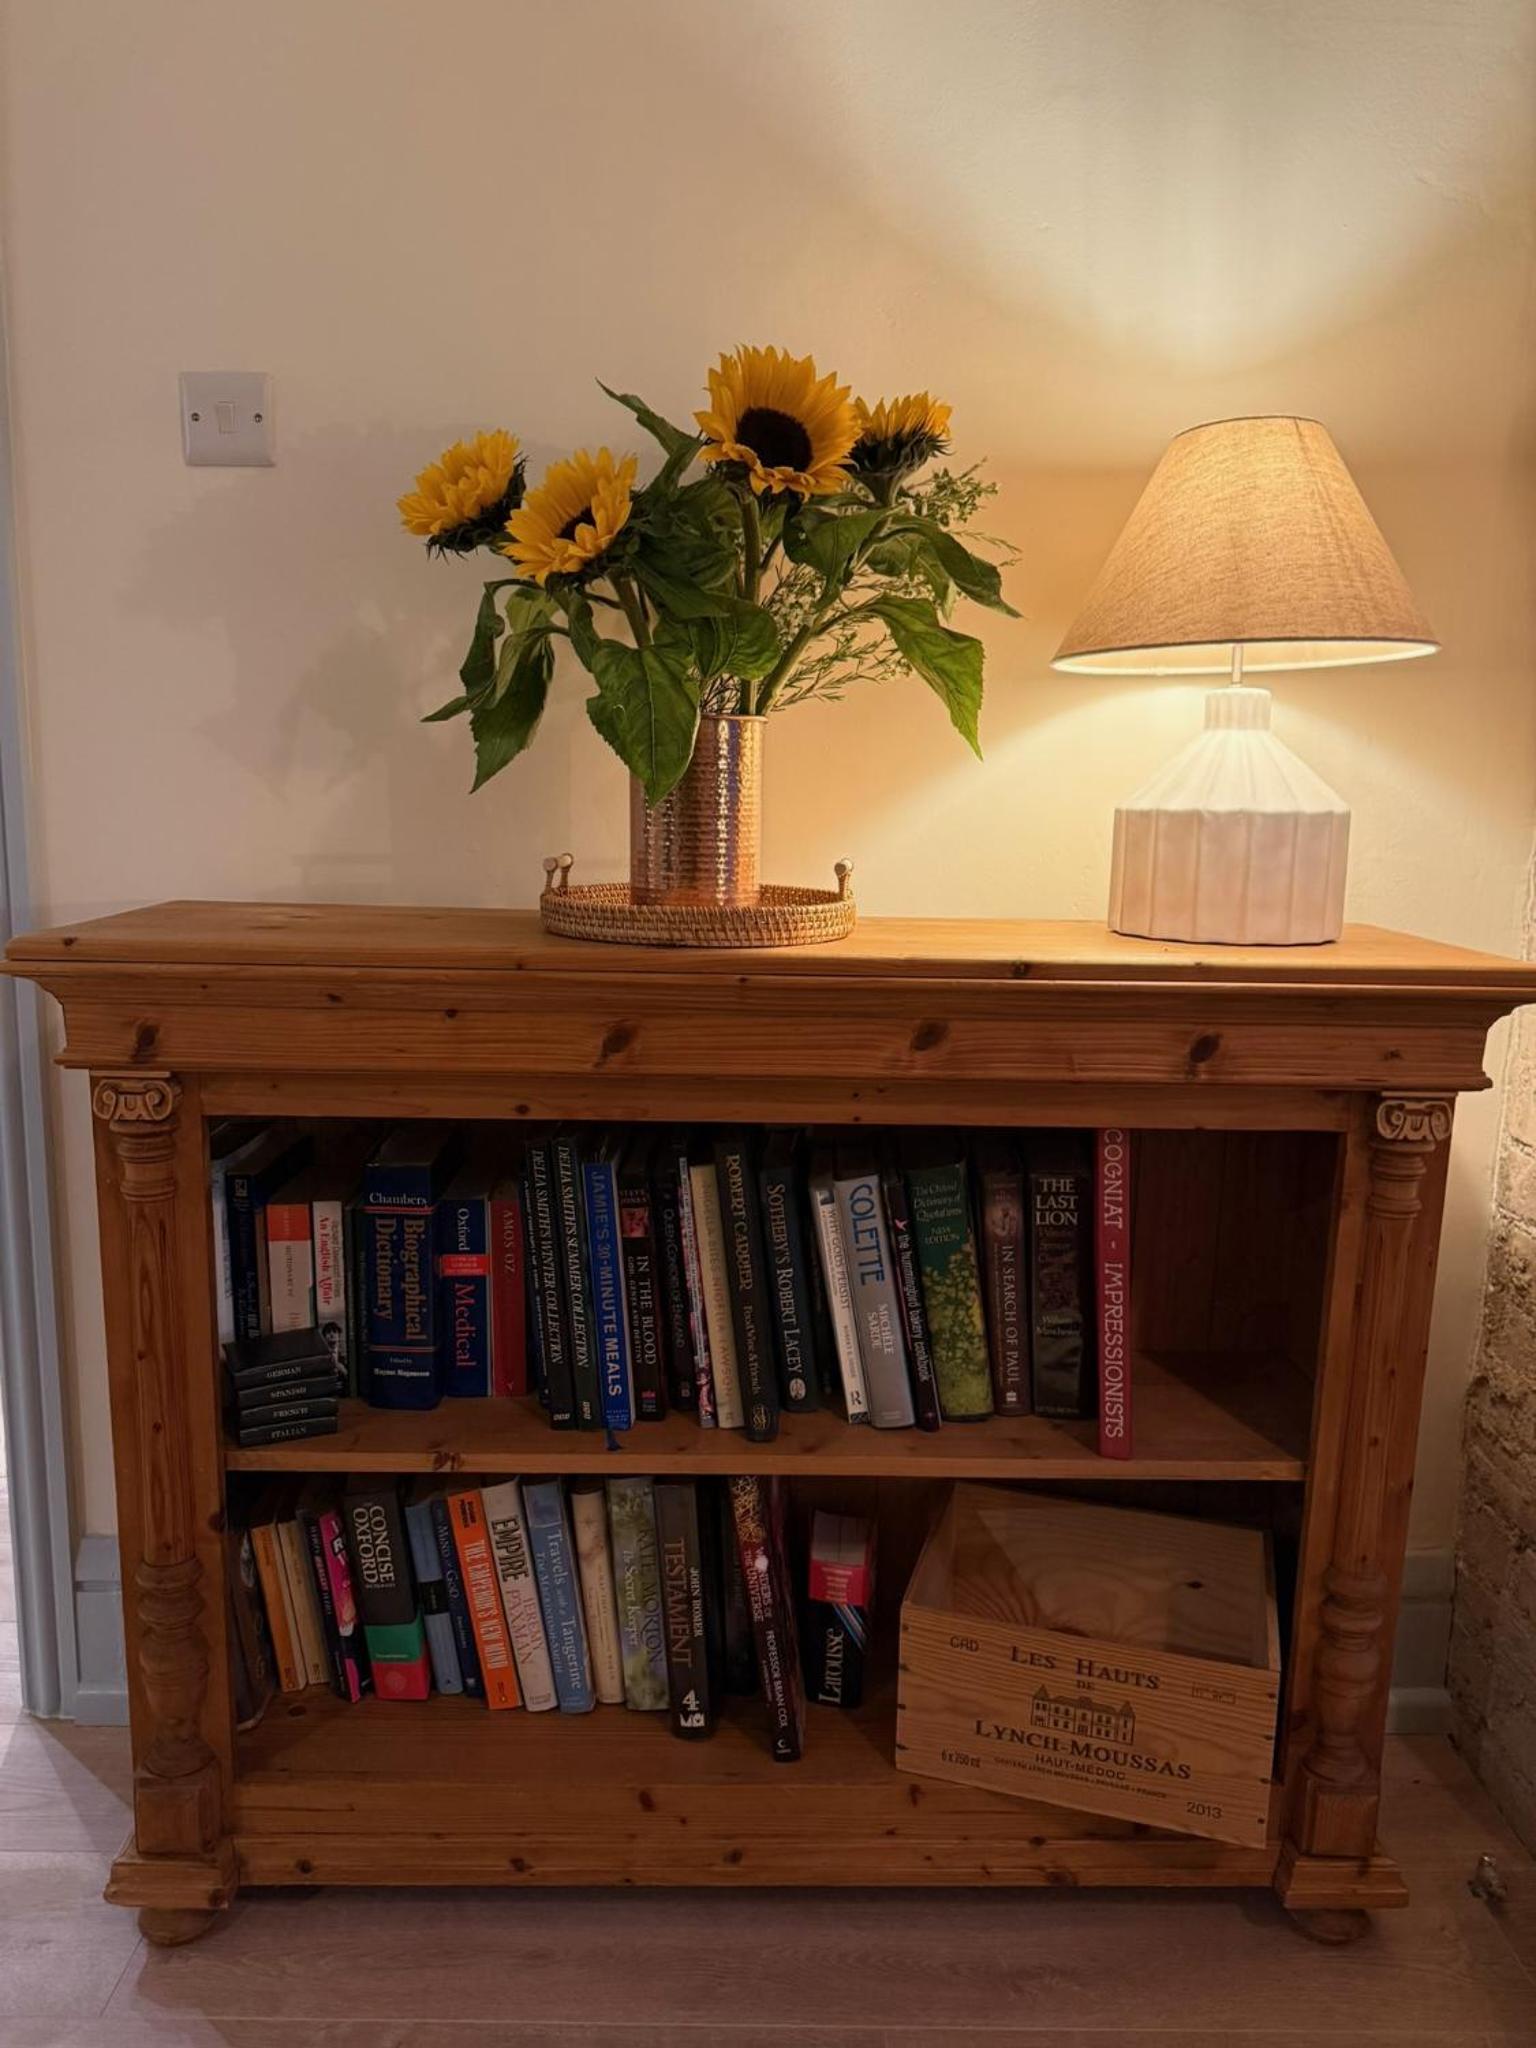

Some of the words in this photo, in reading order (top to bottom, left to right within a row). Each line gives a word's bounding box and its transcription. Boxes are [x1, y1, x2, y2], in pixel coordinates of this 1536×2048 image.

[532, 1150, 547, 1187] DELIA
[558, 1146, 573, 1183] DELIA
[1039, 1179, 1076, 1193] THE
[1103, 1128, 1123, 1230] COGNIAT
[369, 1192, 428, 1206] Chambers
[591, 1171, 611, 1241] JAMIE'S
[725, 1154, 747, 1219] ROBERT
[1036, 1195, 1079, 1210] LAST
[320, 1215, 330, 1230] An
[457, 1208, 471, 1251] Oxford
[503, 1209, 515, 1248] AMOS
[536, 1189, 552, 1237] SMITH'S
[562, 1184, 578, 1236] SMITH'S
[701, 1184, 716, 1235] NIGELLA
[766, 1184, 790, 1264] SOTHEBY'S
[828, 1209, 841, 1235] WHY
[916, 1207, 963, 1222] Quotations
[1035, 1210, 1080, 1226] LION
[319, 1233, 331, 1272] English
[707, 1240, 720, 1273] BITES
[832, 1237, 844, 1268] GODS
[849, 1184, 885, 1286] COLETTE
[897, 1234, 910, 1249] the
[1002, 1244, 1014, 1263] IN
[374, 1217, 397, 1320] Dictionary
[503, 1254, 516, 1274] OZ
[541, 1241, 557, 1288] WINTER
[567, 1237, 582, 1290] SUMMER
[637, 1255, 651, 1272] IN
[733, 1221, 754, 1293] CARRIER
[319, 1277, 332, 1305] Affair
[401, 1218, 428, 1340] Biographical
[596, 1243, 617, 1334] 30-MINUTE
[639, 1280, 653, 1312] THE
[776, 1267, 797, 1325] ROBERT
[836, 1270, 850, 1310] PERSIST
[900, 1251, 919, 1308] hummingbird
[1003, 1267, 1017, 1322] SEARCH
[711, 1275, 726, 1331] NIGELLA
[908, 1310, 924, 1339] bakery
[454, 1282, 476, 1368] Medical
[543, 1290, 563, 1365] COLLECTION
[571, 1292, 588, 1368] COLLECTION
[642, 1316, 657, 1364] BLOOD
[1005, 1327, 1018, 1345] OF
[604, 1337, 622, 1396] MEALS
[716, 1335, 732, 1396] LAWSON
[784, 1329, 803, 1374] LACEY
[914, 1342, 931, 1382] cookbook
[1006, 1351, 1020, 1385] PAUL
[1103, 1261, 1124, 1439] IMPRESSIONISTS
[266, 1366, 301, 1378] GERMAN
[270, 1386, 306, 1399] SPANISH
[748, 1362, 761, 1396] Friends
[271, 1426, 307, 1439] ITALIAN
[273, 1407, 308, 1418] FRENCH
[353, 1507, 379, 1583] OXFORD
[369, 1505, 396, 1583] CONCISE
[437, 1524, 450, 1558] MIND
[446, 1569, 460, 1599] GOD
[463, 1540, 485, 1560] THE
[491, 1518, 529, 1582] EMPIRE
[535, 1552, 547, 1572] TIM
[623, 1550, 633, 1563] The
[639, 1529, 655, 1572] KATE
[467, 1563, 499, 1619] EMPEROR'S
[625, 1566, 639, 1601] Secret
[664, 1537, 693, 1668] TESTAMENT
[689, 1567, 701, 1597] JOHN
[745, 1568, 764, 1622] UNIVERSE
[480, 1620, 504, 1641] NEW
[506, 1590, 532, 1664] PAXMAN
[522, 1598, 542, 1650] JEREMY
[547, 1529, 568, 1585] Travels
[561, 1616, 582, 1689] Tangerine
[623, 1606, 640, 1648] Keeper
[641, 1582, 663, 1663] MORTON
[691, 1600, 703, 1637] ROMER
[484, 1642, 508, 1669] MIND
[765, 1629, 782, 1679] PROFESSOR
[818, 1627, 845, 1705] Larousse
[1010, 1646, 1057, 1669] LES
[1076, 1657, 1160, 1690] HAUTS
[773, 1680, 784, 1706] BRIAN
[1077, 1680, 1096, 1691] DE
[777, 1708, 788, 1728] COX
[975, 1720, 1191, 1780] LYNCH-MOUSSAS
[1186, 1801, 1222, 1820] 2013
